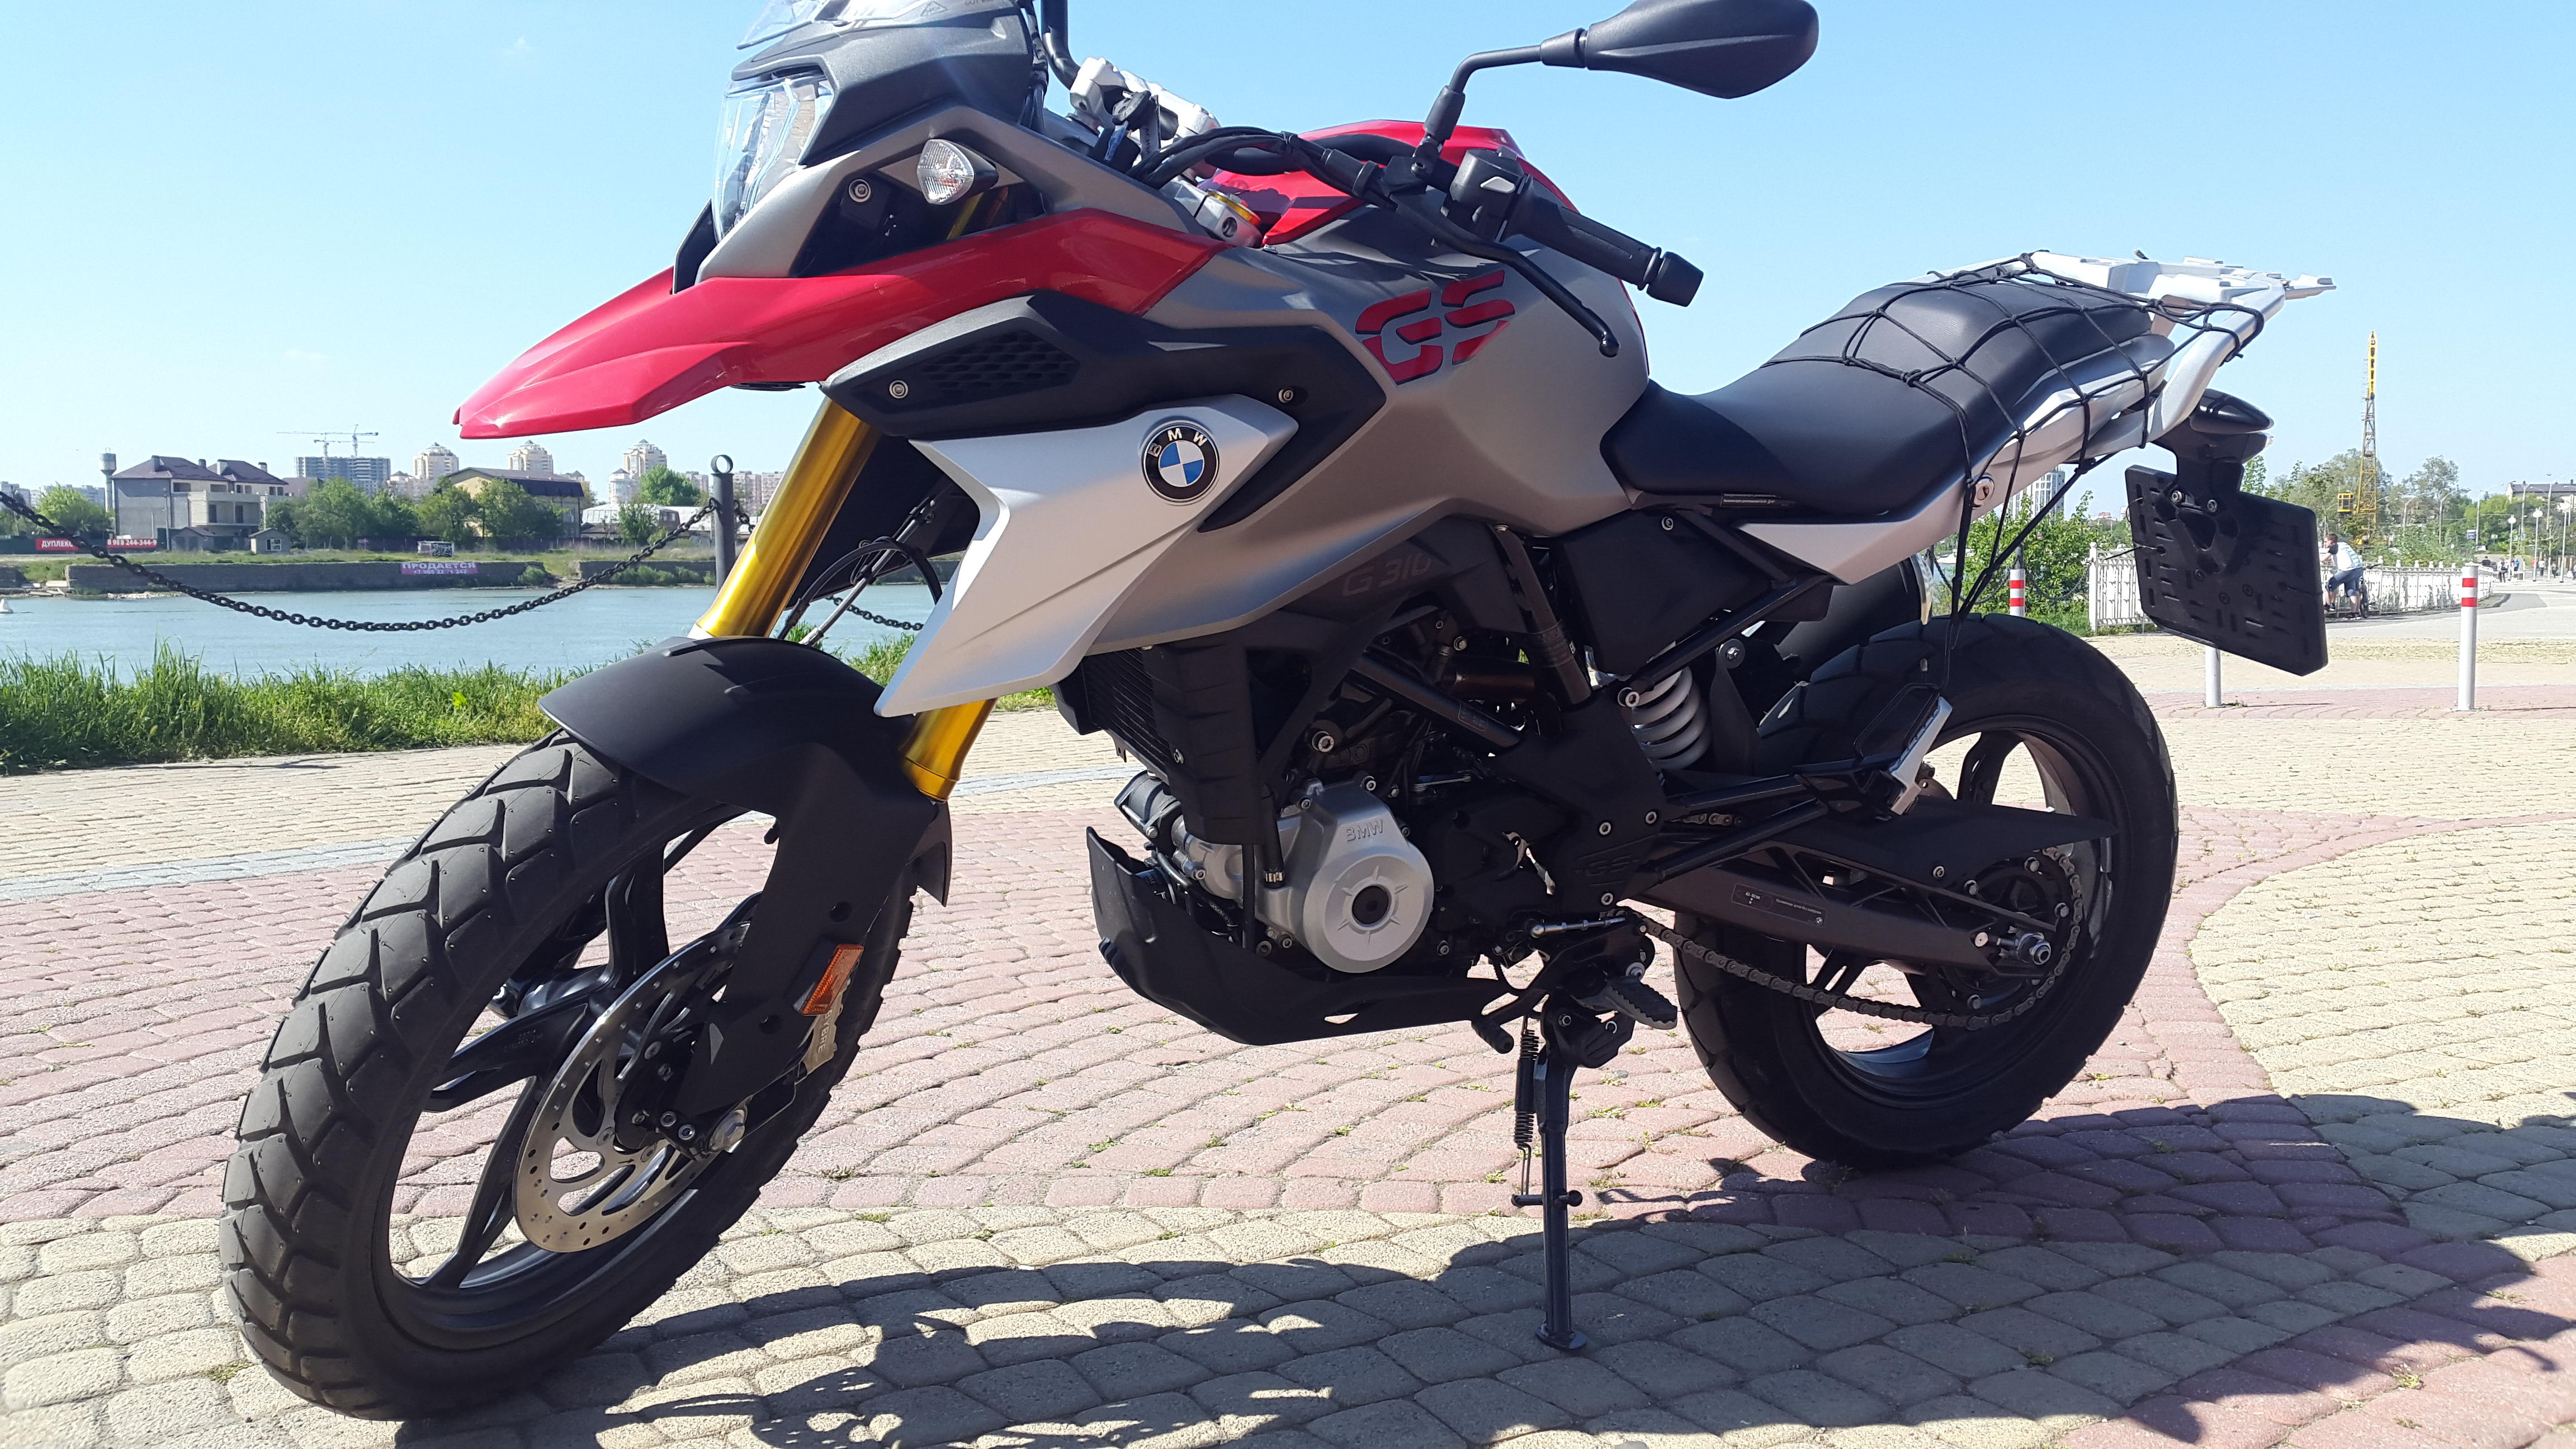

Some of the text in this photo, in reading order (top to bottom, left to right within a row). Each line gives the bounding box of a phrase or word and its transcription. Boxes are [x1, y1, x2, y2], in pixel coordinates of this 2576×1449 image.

[1355, 270, 1516, 385] GS
[1147, 428, 1208, 457] BMW
[1341, 552, 1433, 597] G 310
[1346, 819, 1383, 842] BMW
[817, 1008, 833, 1053] BYBRE
